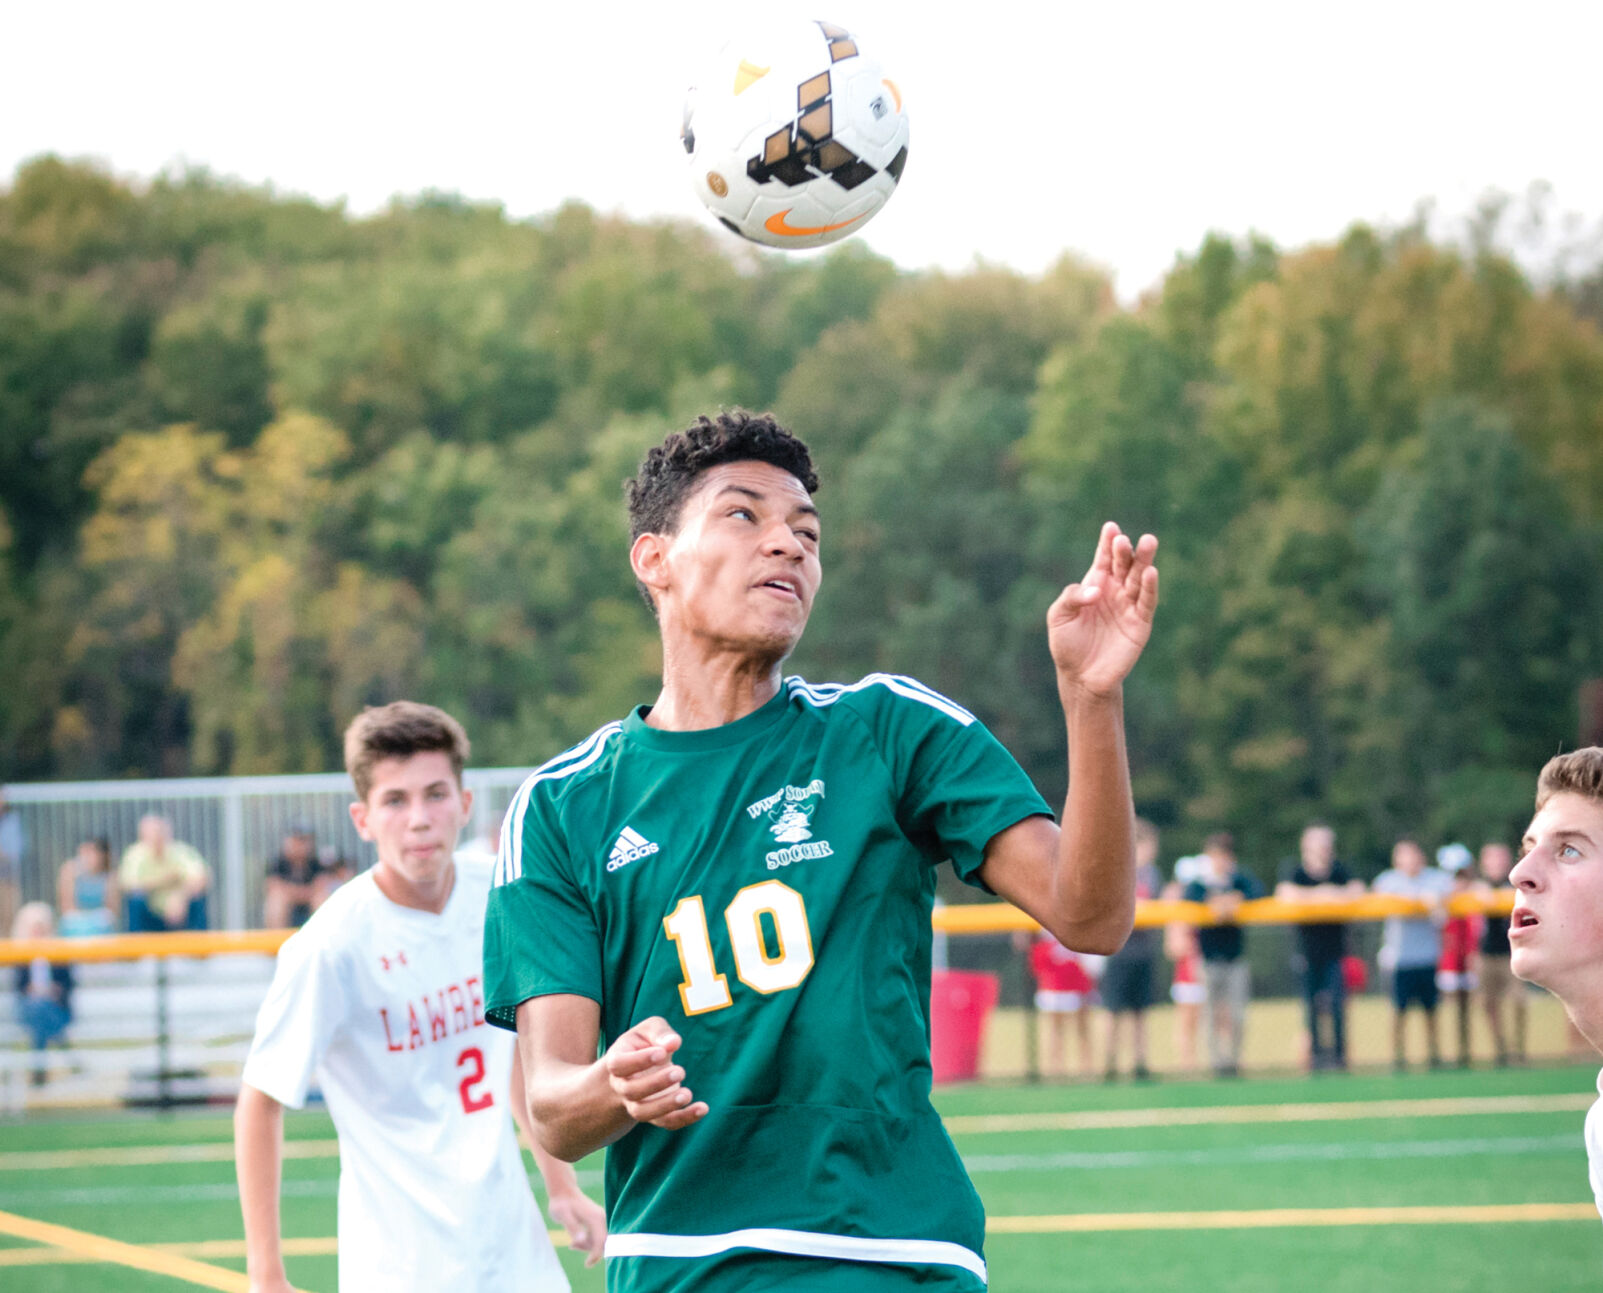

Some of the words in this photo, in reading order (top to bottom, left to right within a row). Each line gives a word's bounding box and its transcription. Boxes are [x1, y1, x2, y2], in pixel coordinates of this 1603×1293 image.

[606, 842, 659, 872] adidas
[765, 840, 834, 870] SOCCER
[662, 879, 815, 1016] 10
[380, 978, 485, 1051] LAWRE
[456, 1046, 494, 1114] 2
